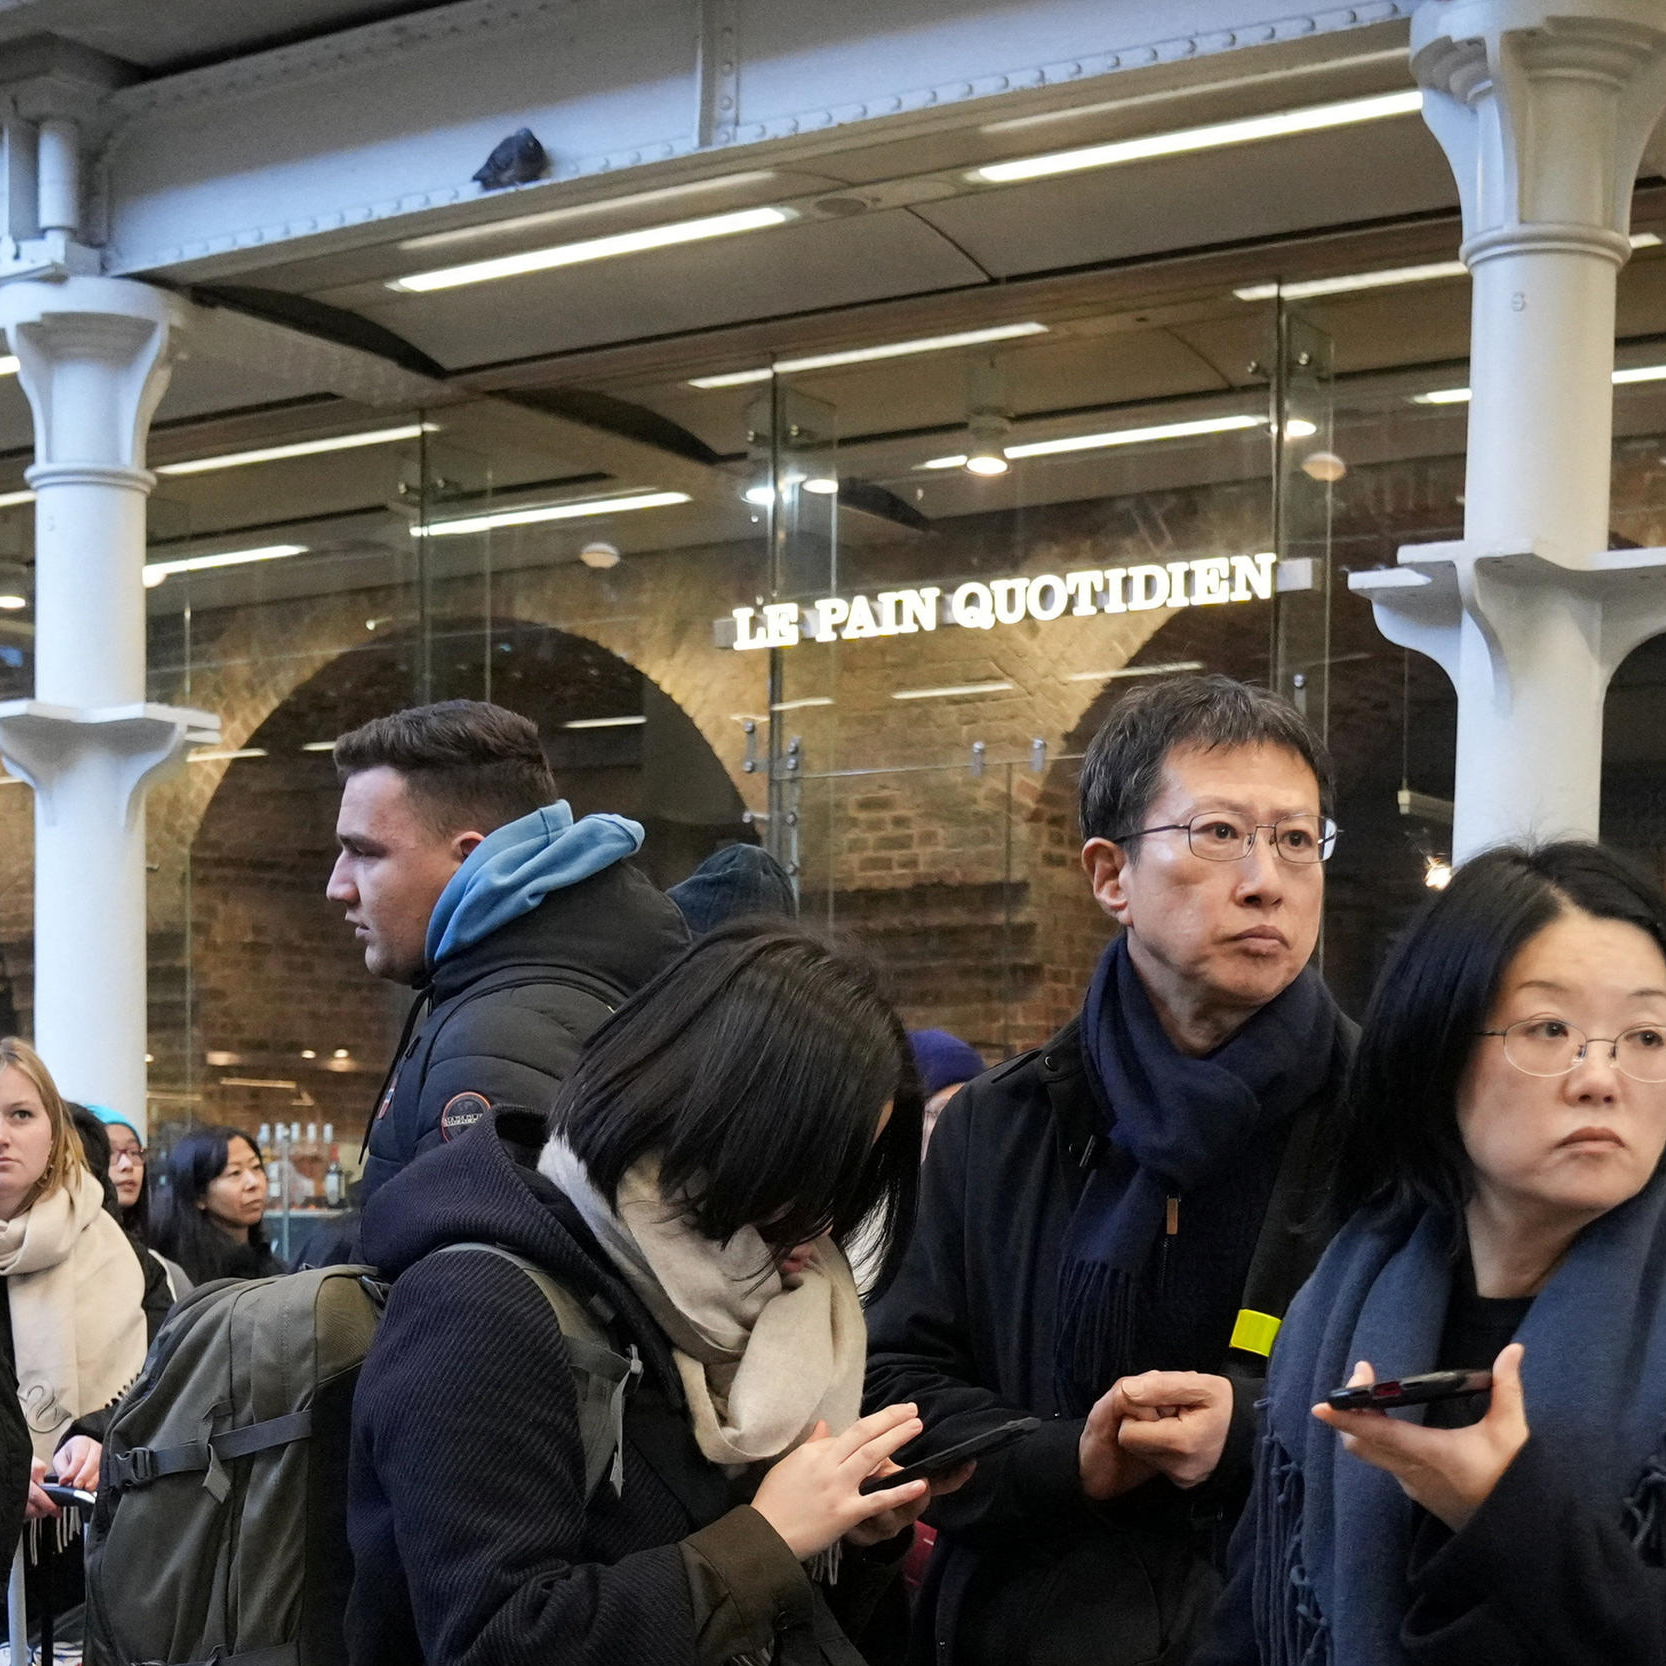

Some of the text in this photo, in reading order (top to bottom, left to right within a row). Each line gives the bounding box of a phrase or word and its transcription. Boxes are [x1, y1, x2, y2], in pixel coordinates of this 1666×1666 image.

[732, 552, 1277, 651] LE PAIN QUOTIDIEN
